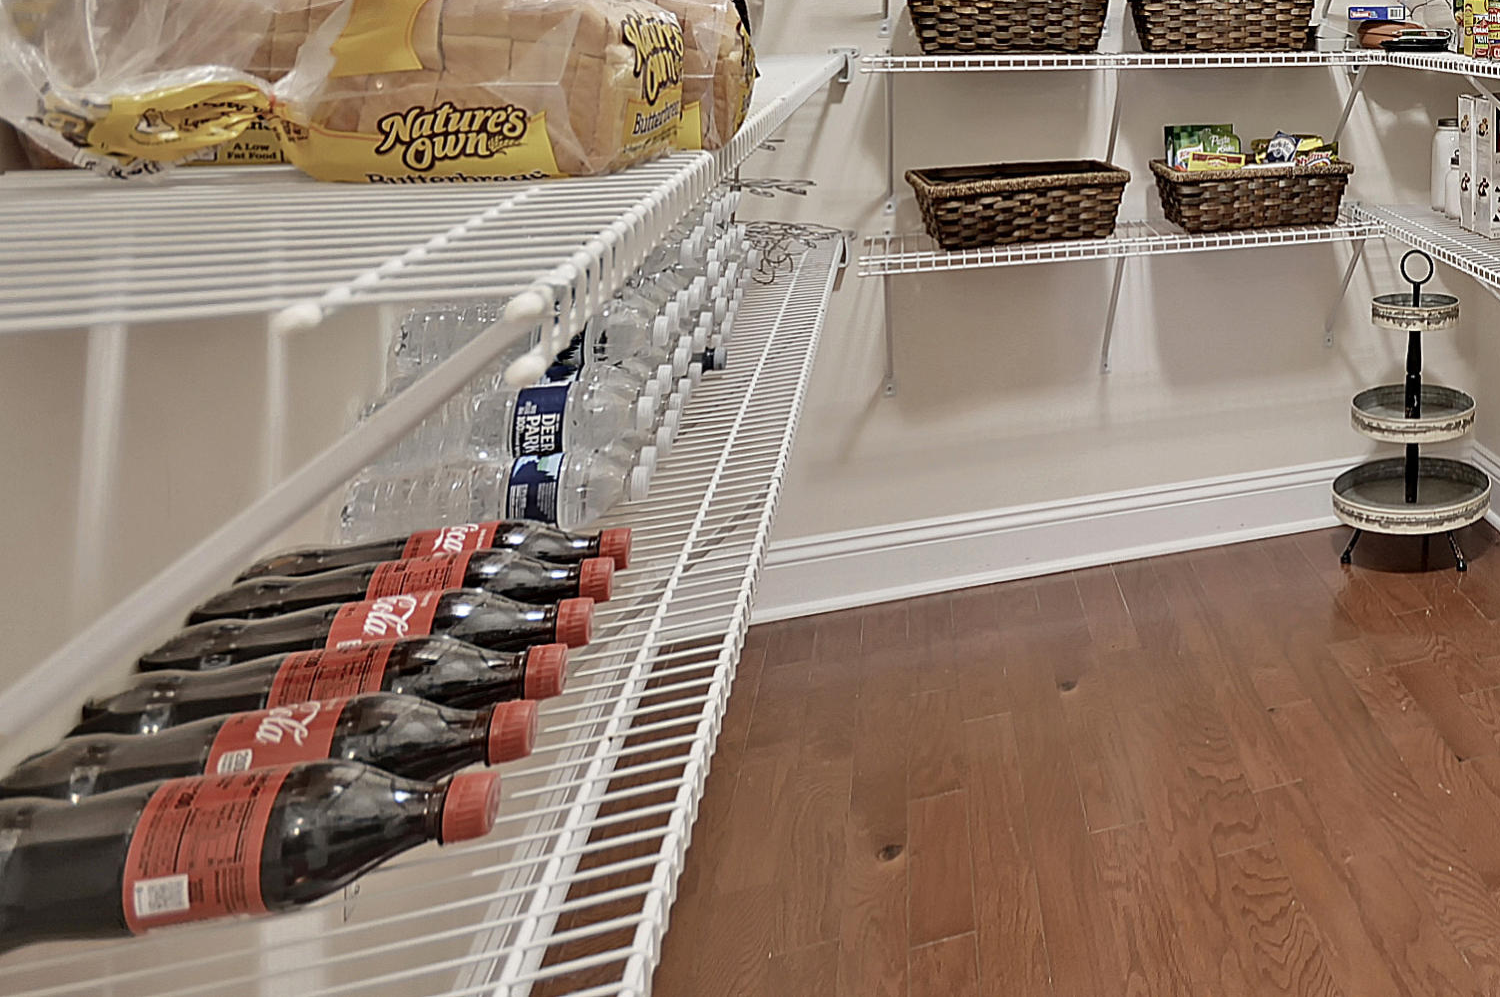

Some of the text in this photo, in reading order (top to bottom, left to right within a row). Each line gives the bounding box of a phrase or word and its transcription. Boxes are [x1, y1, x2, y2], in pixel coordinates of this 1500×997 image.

[375, 101, 528, 154] Nature's
[227, 152, 277, 160] Fat Food
[233, 143, 270, 151] A Low
[402, 131, 494, 171] Own
[523, 415, 541, 453] PARK
[541, 413, 557, 452] DEER
